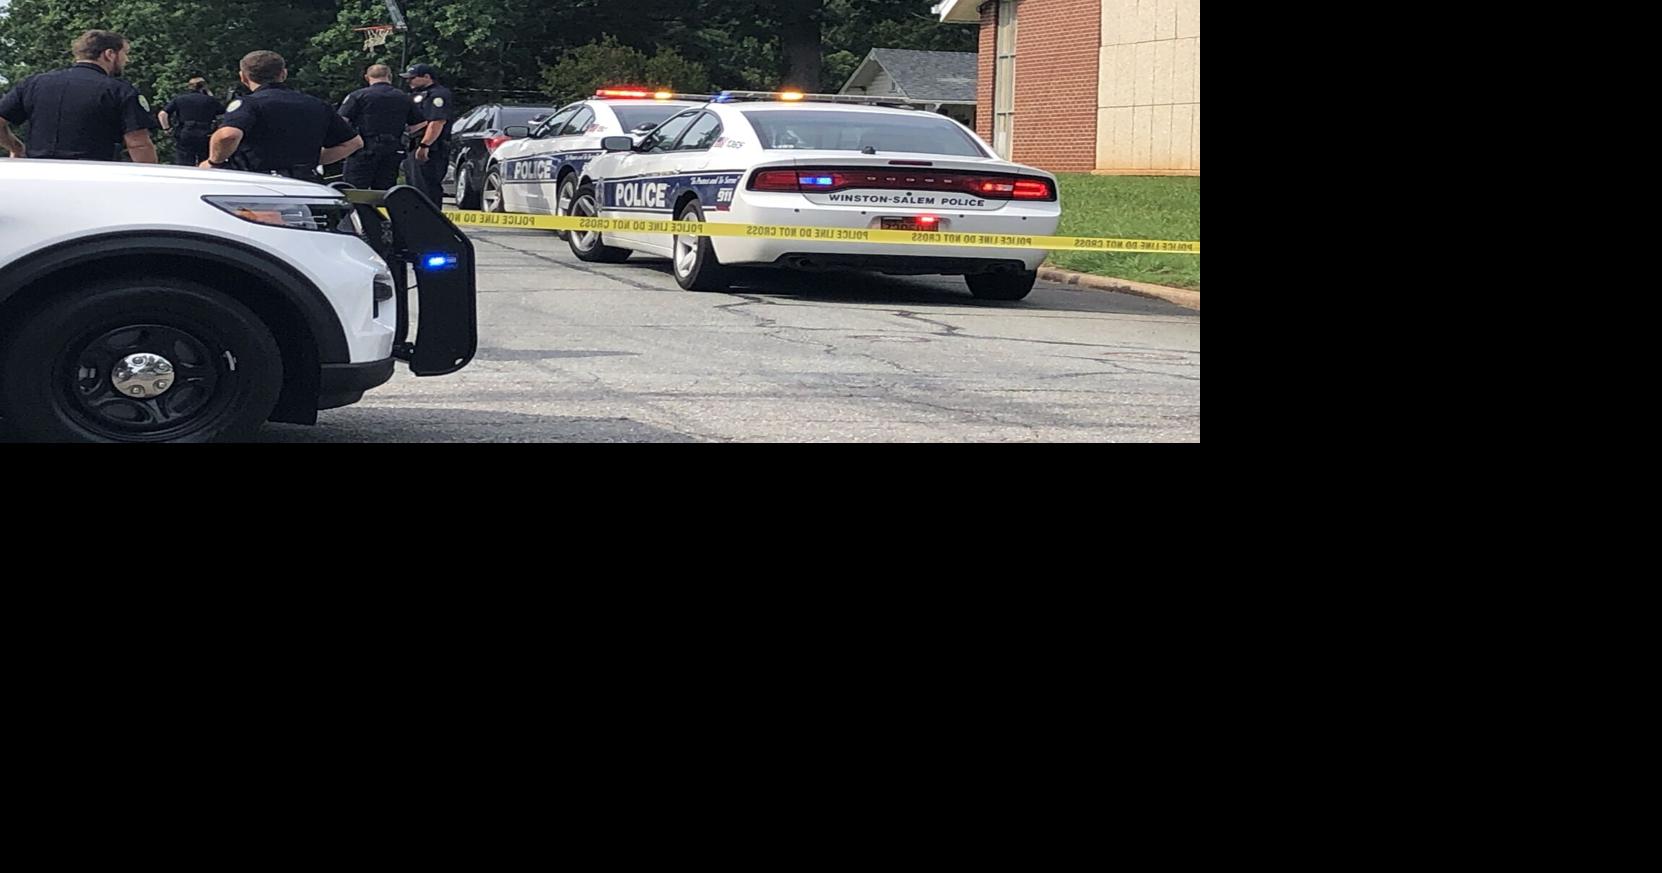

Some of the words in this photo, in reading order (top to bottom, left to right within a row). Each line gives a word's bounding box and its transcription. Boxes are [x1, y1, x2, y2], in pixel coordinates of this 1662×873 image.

[513, 160, 553, 179] POLICE
[615, 182, 668, 207] POLICE
[717, 189, 733, 202] 911
[829, 194, 935, 205] WINSTON-SALEM
[941, 198, 985, 207] POLICE
